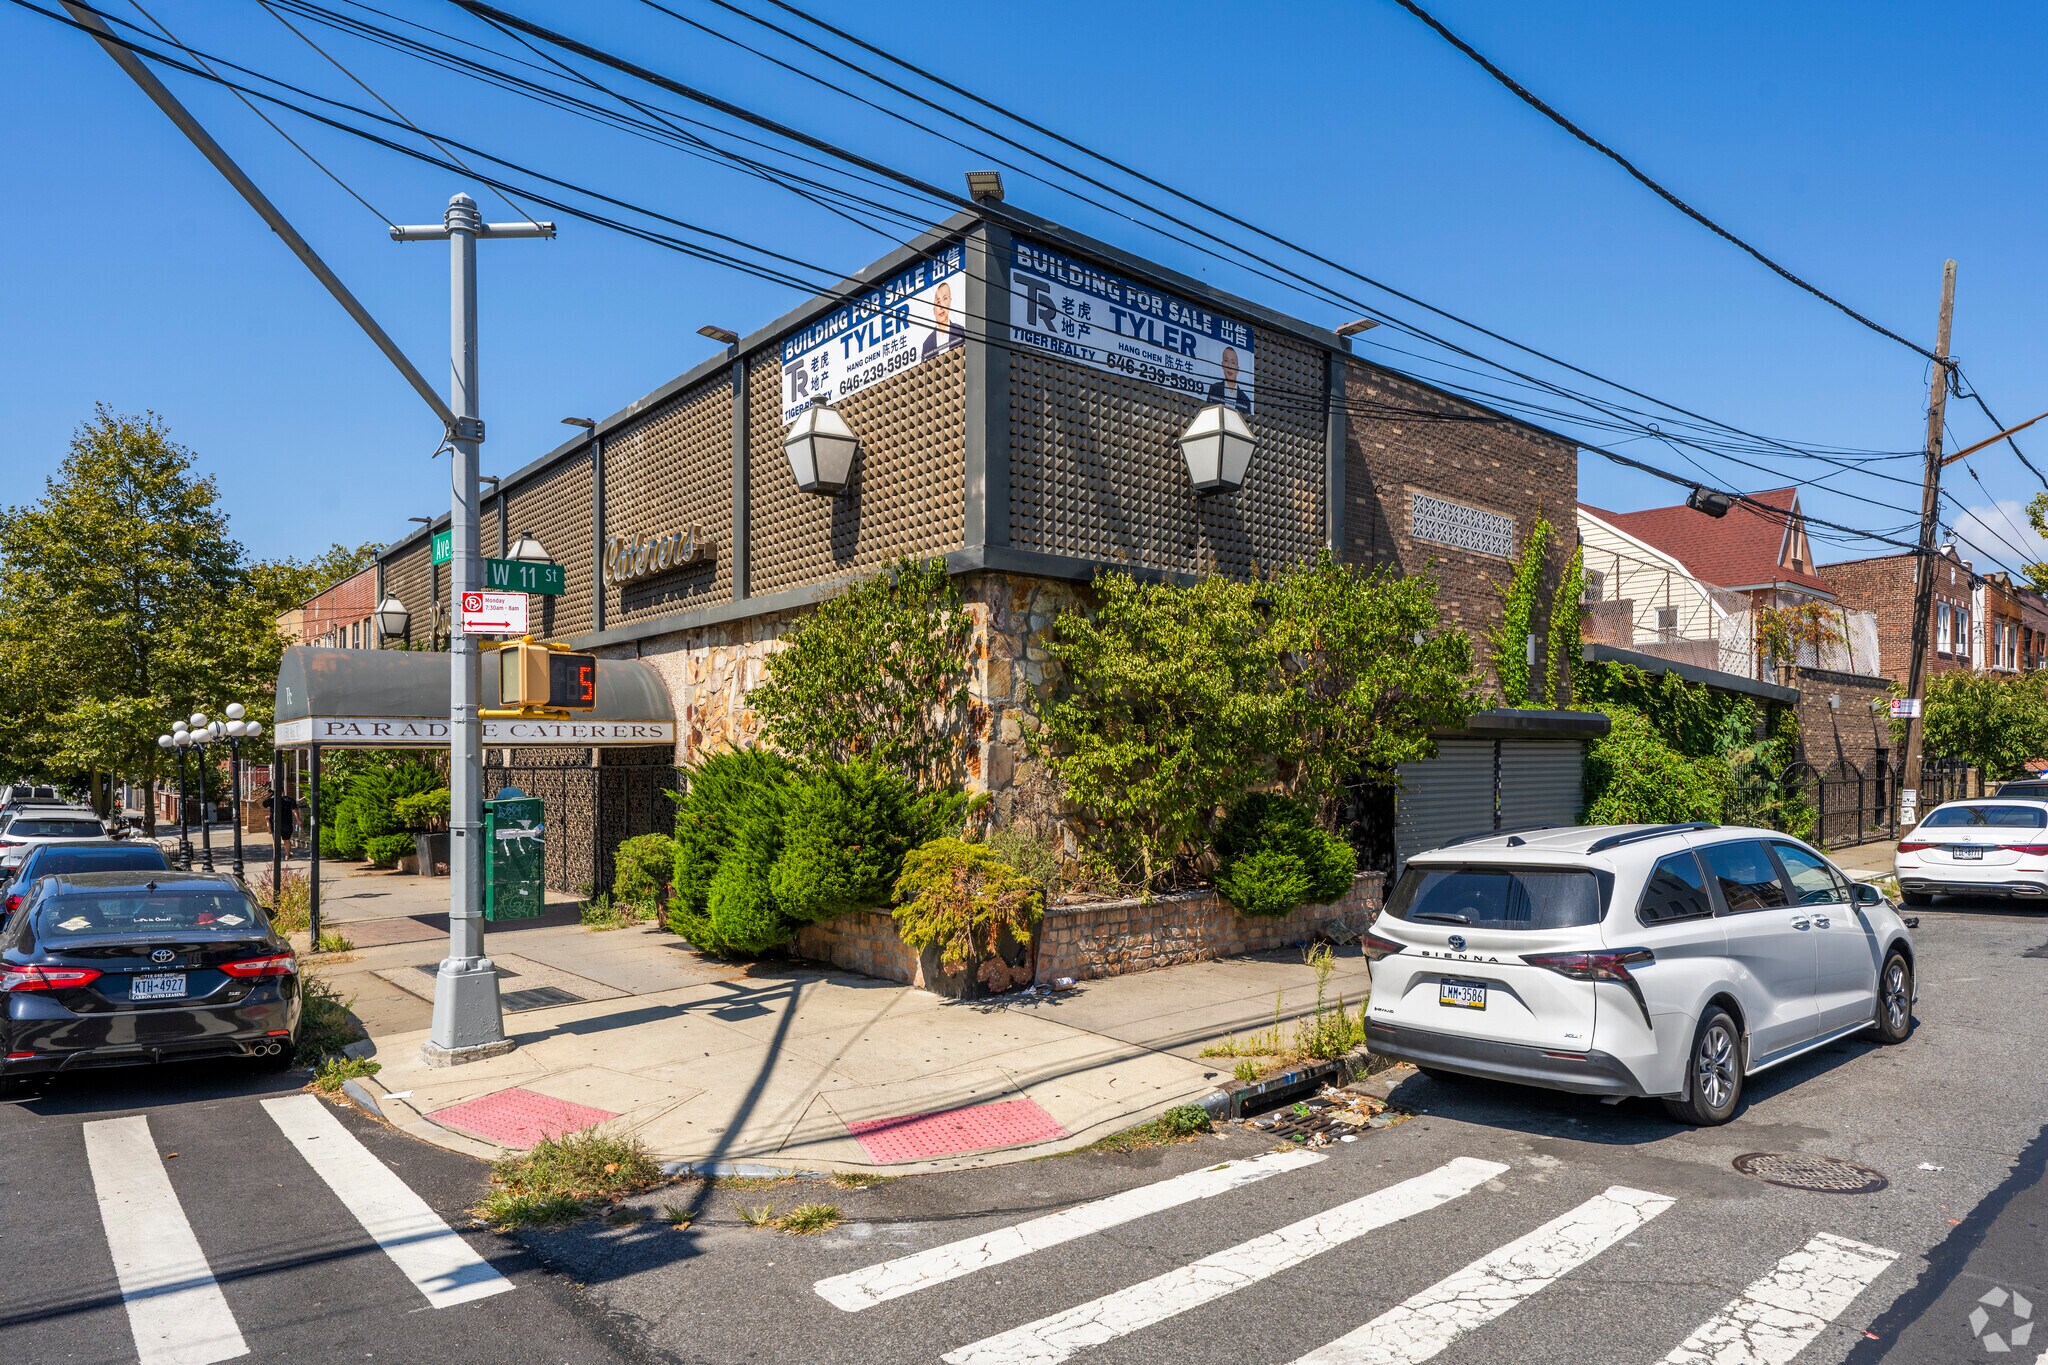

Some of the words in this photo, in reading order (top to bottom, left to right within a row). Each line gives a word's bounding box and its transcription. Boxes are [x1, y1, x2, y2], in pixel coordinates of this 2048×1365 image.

[786, 308, 848, 361] BUILDING
[852, 293, 880, 324] FOR
[885, 267, 925, 306] SALE
[933, 247, 961, 283] 出售
[1017, 244, 1120, 302] BUILDING
[1126, 285, 1164, 317] FOR
[1168, 301, 1213, 335] SALE
[1221, 320, 1248, 347] 出售
[1061, 296, 1091, 321] 老虎
[840, 303, 910, 360] TYLER
[1012, 327, 1048, 348] TIGER
[1050, 340, 1096, 360] REALTY
[1061, 317, 1091, 340] 地产
[1109, 306, 1198, 360] TYLER
[811, 351, 829, 373] 老虎
[846, 359, 864, 373] HANG
[865, 351, 881, 365] CHEN
[883, 335, 908, 358] 陈先生
[1118, 342, 1141, 356] HANG
[1142, 350, 1163, 363] CHEN
[1164, 353, 1194, 374] 陈先生
[811, 371, 829, 392] 地产
[839, 347, 917, 396] 646-239-5999
[1106, 352, 1205, 395] 646-239-5999
[785, 403, 804, 421] TIGER
[436, 538, 450, 561] Ave
[603, 523, 702, 588] Caterers
[492, 563, 510, 587] W
[519, 566, 537, 589] 11
[546, 569, 558, 583] St
[579, 666, 593, 701] 5
[324, 722, 498, 738] PARADE
[510, 724, 664, 738] CATERERS
[1422, 951, 1499, 963] SIENNA
